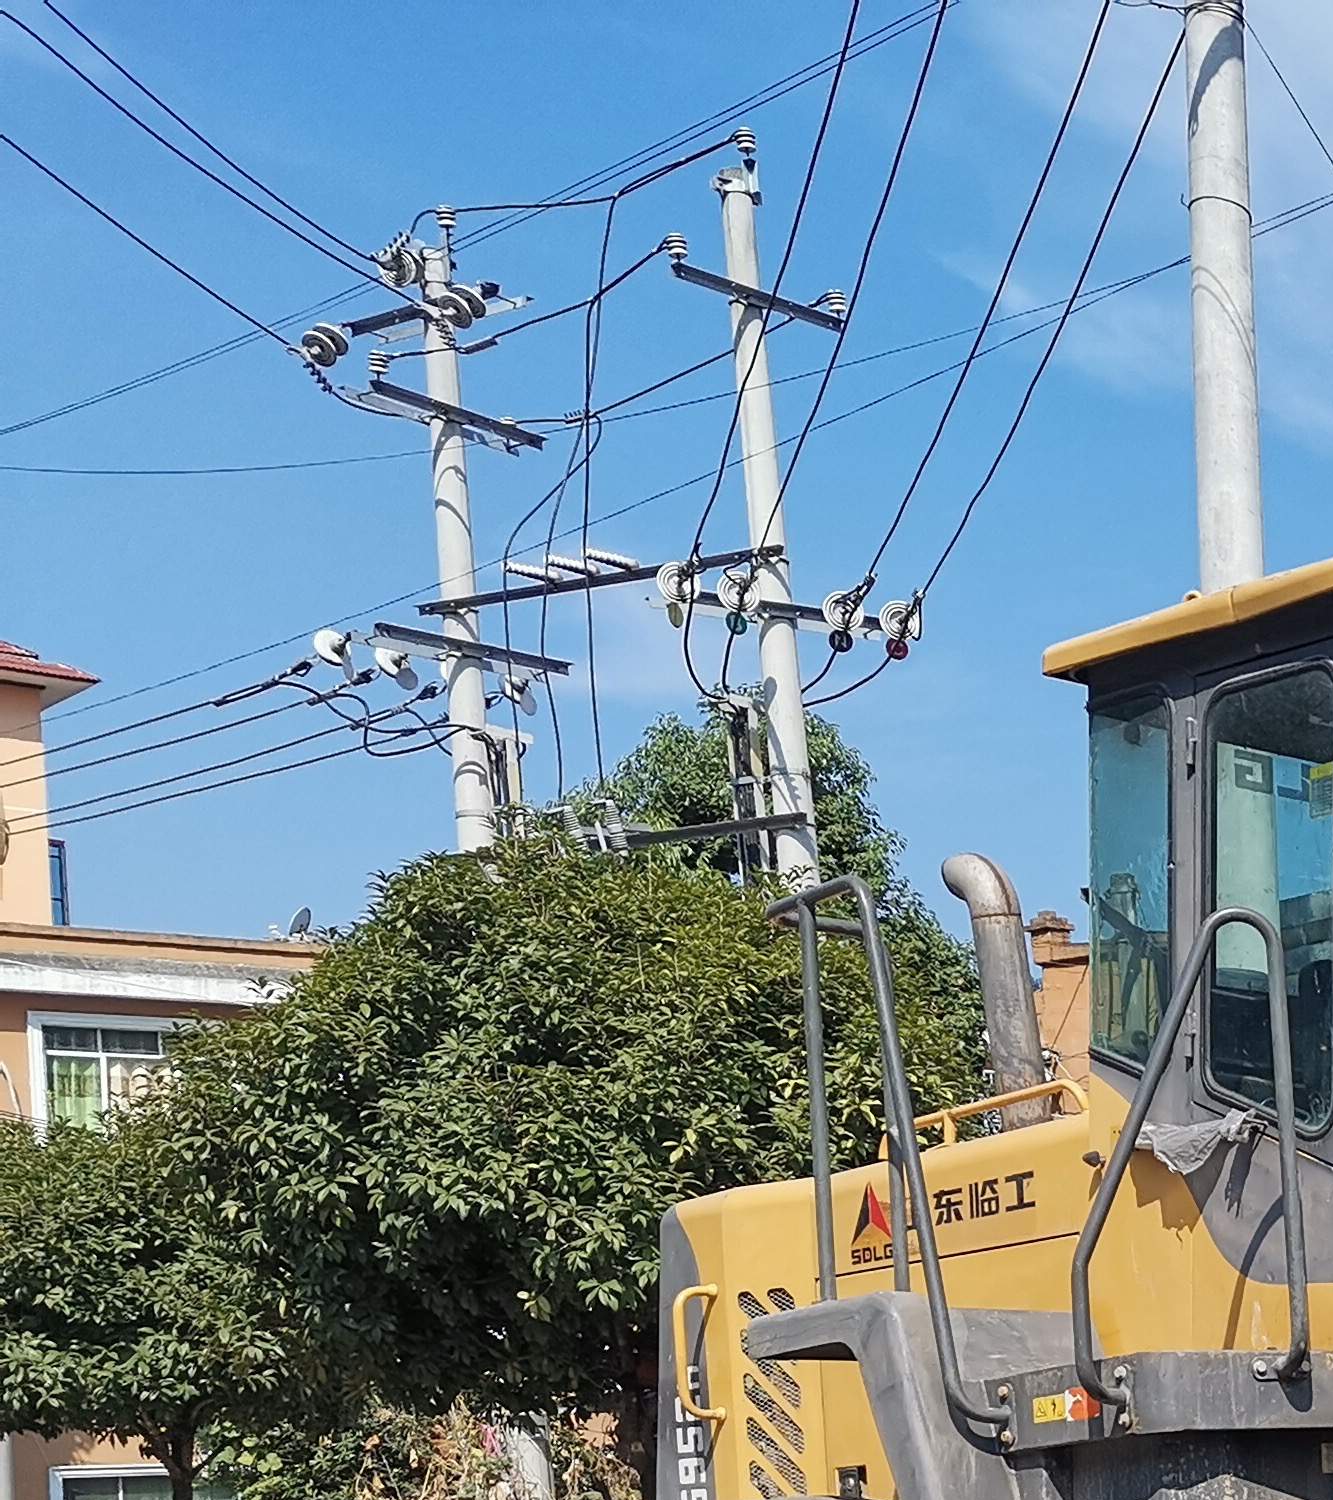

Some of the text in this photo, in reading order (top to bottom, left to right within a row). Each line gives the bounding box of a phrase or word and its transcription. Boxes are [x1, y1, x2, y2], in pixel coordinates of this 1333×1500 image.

[907, 1170, 1037, 1230] 东临工
[851, 1244, 896, 1265] SDLG
